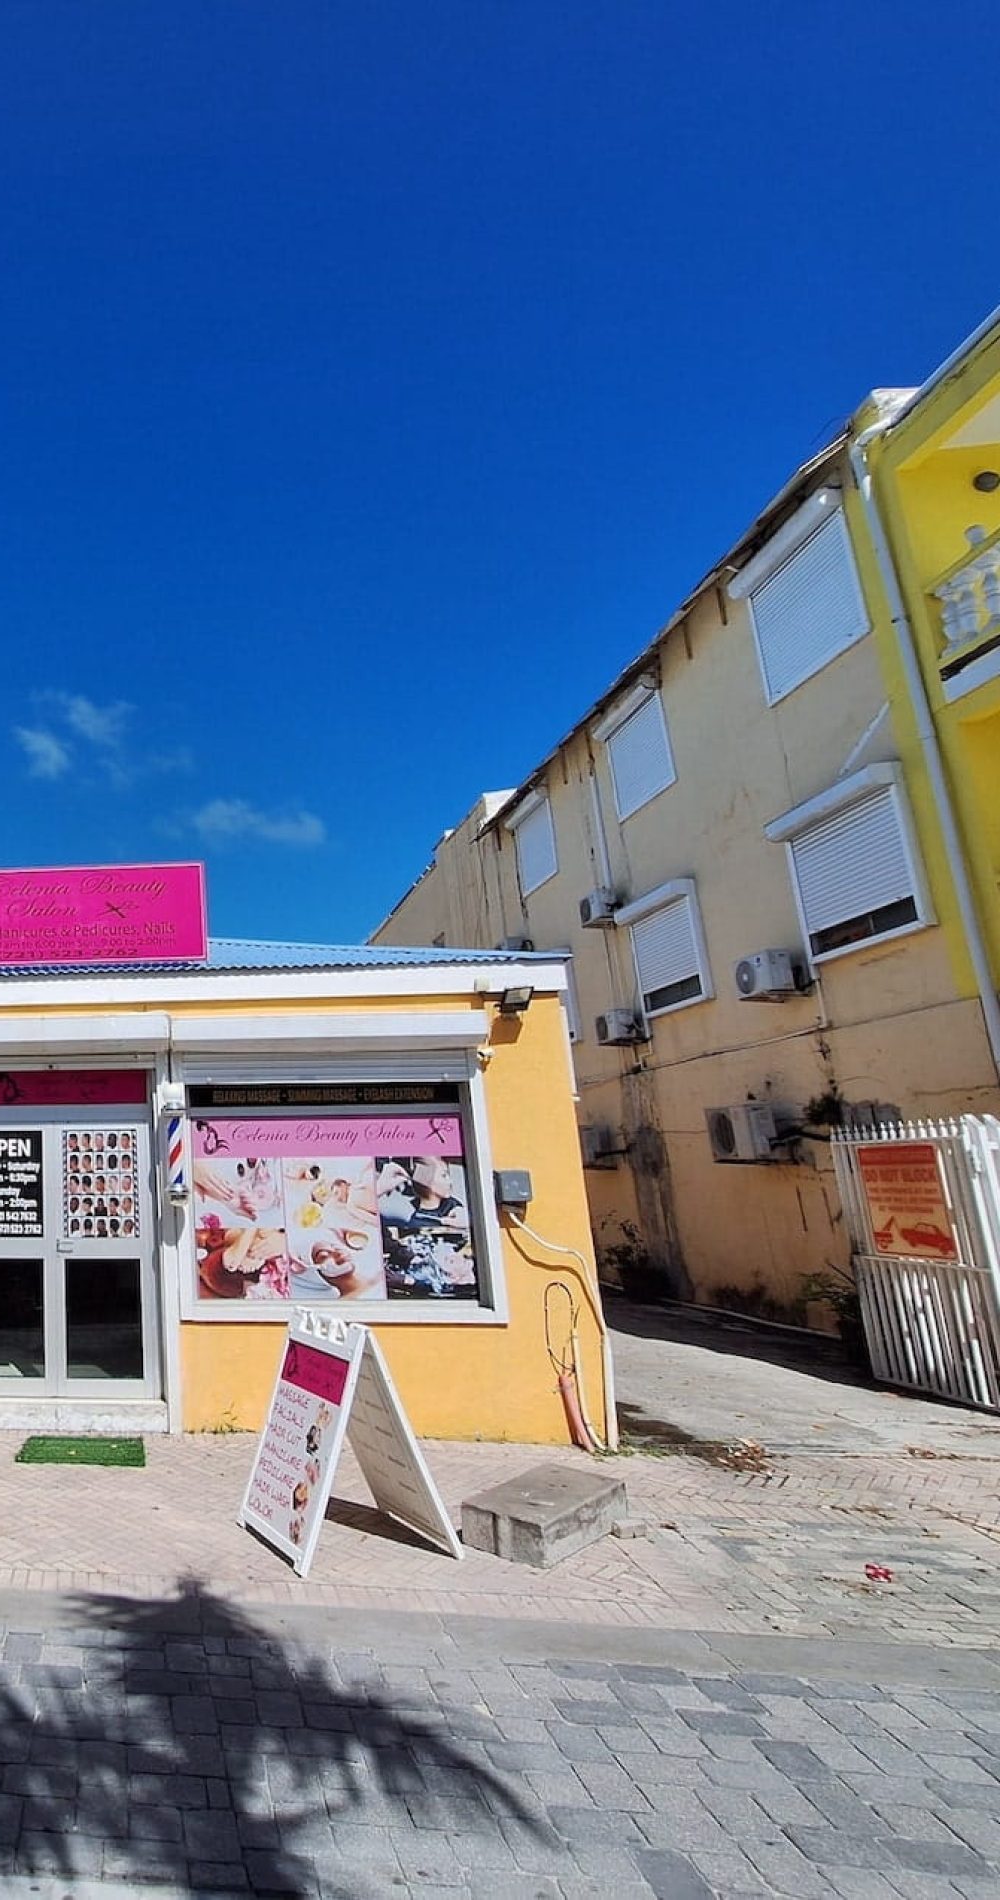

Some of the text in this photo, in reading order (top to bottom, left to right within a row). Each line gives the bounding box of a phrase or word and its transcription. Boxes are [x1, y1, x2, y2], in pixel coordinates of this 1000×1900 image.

[80, 872, 168, 901] Beauty
[6, 897, 79, 918] Salon
[144, 920, 176, 935] Nails
[296, 1120, 359, 1147] Beauty
[364, 1121, 416, 1142] Salon
[7, 1161, 40, 1173] Saturday
